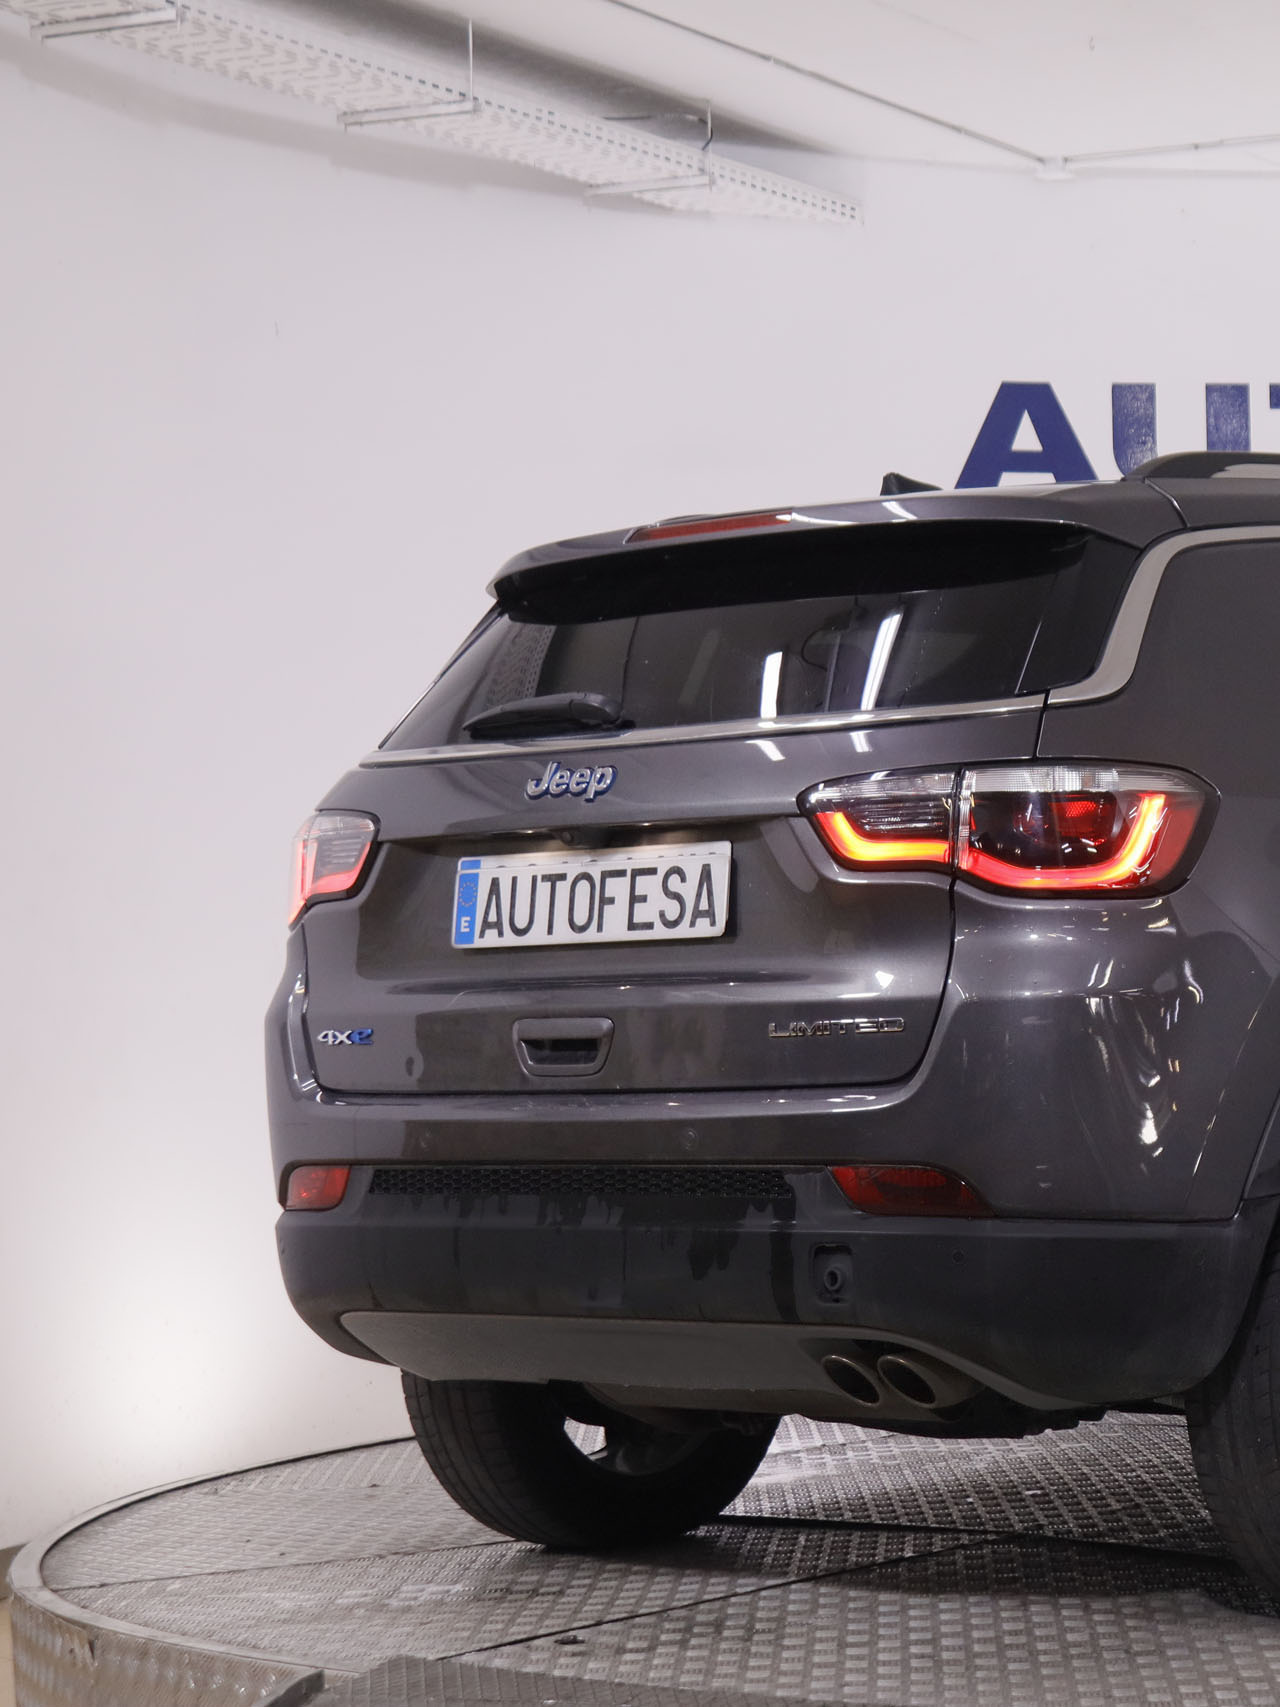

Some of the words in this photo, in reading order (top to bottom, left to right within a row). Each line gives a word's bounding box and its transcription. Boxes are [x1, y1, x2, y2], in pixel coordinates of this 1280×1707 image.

[525, 761, 617, 802] Jeep
[478, 863, 717, 939] AUTOFESA
[460, 916, 472, 933] E
[768, 1017, 904, 1037] LIMITED
